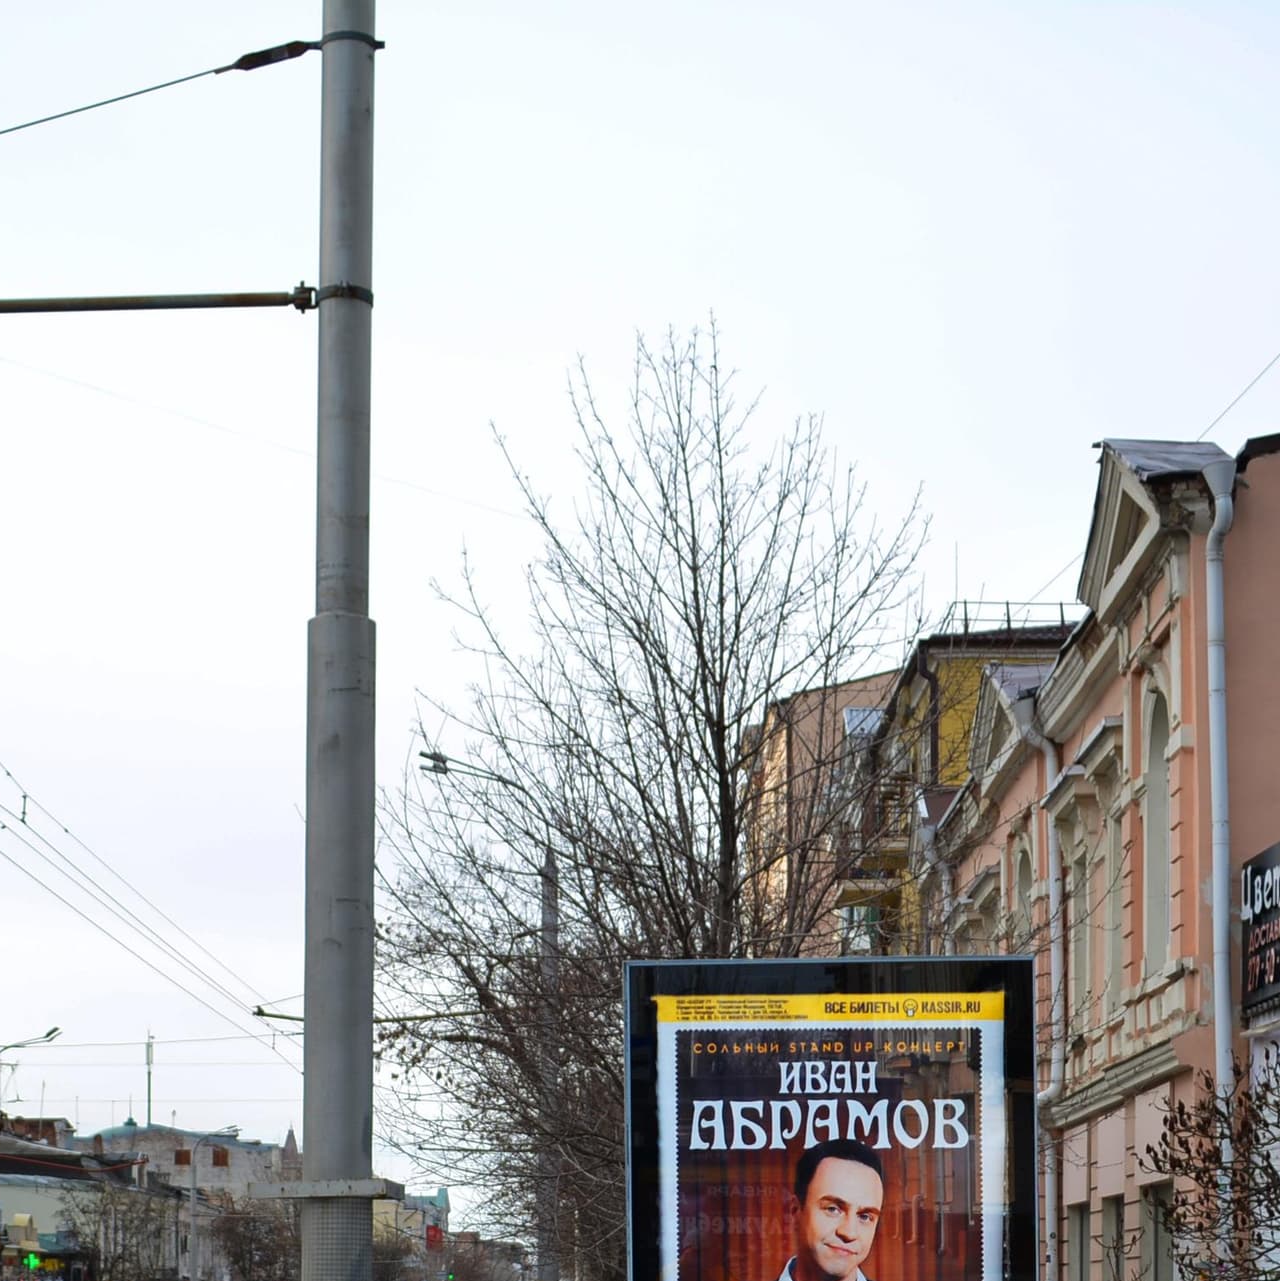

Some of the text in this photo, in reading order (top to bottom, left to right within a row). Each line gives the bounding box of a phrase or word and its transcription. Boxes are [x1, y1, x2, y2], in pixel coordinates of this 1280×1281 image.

[824, 1001, 846, 1014] ВСЕ
[849, 1001, 900, 1014] БИЛЕТЫ
[921, 1000, 981, 1014] KASSIR.RU
[789, 1041, 844, 1054] STAND
[854, 1041, 873, 1053] UP
[883, 1041, 966, 1054] КОНЦЕРТ
[778, 1061, 878, 1094] ИВАН
[689, 1098, 970, 1151] АБРАМОВ
